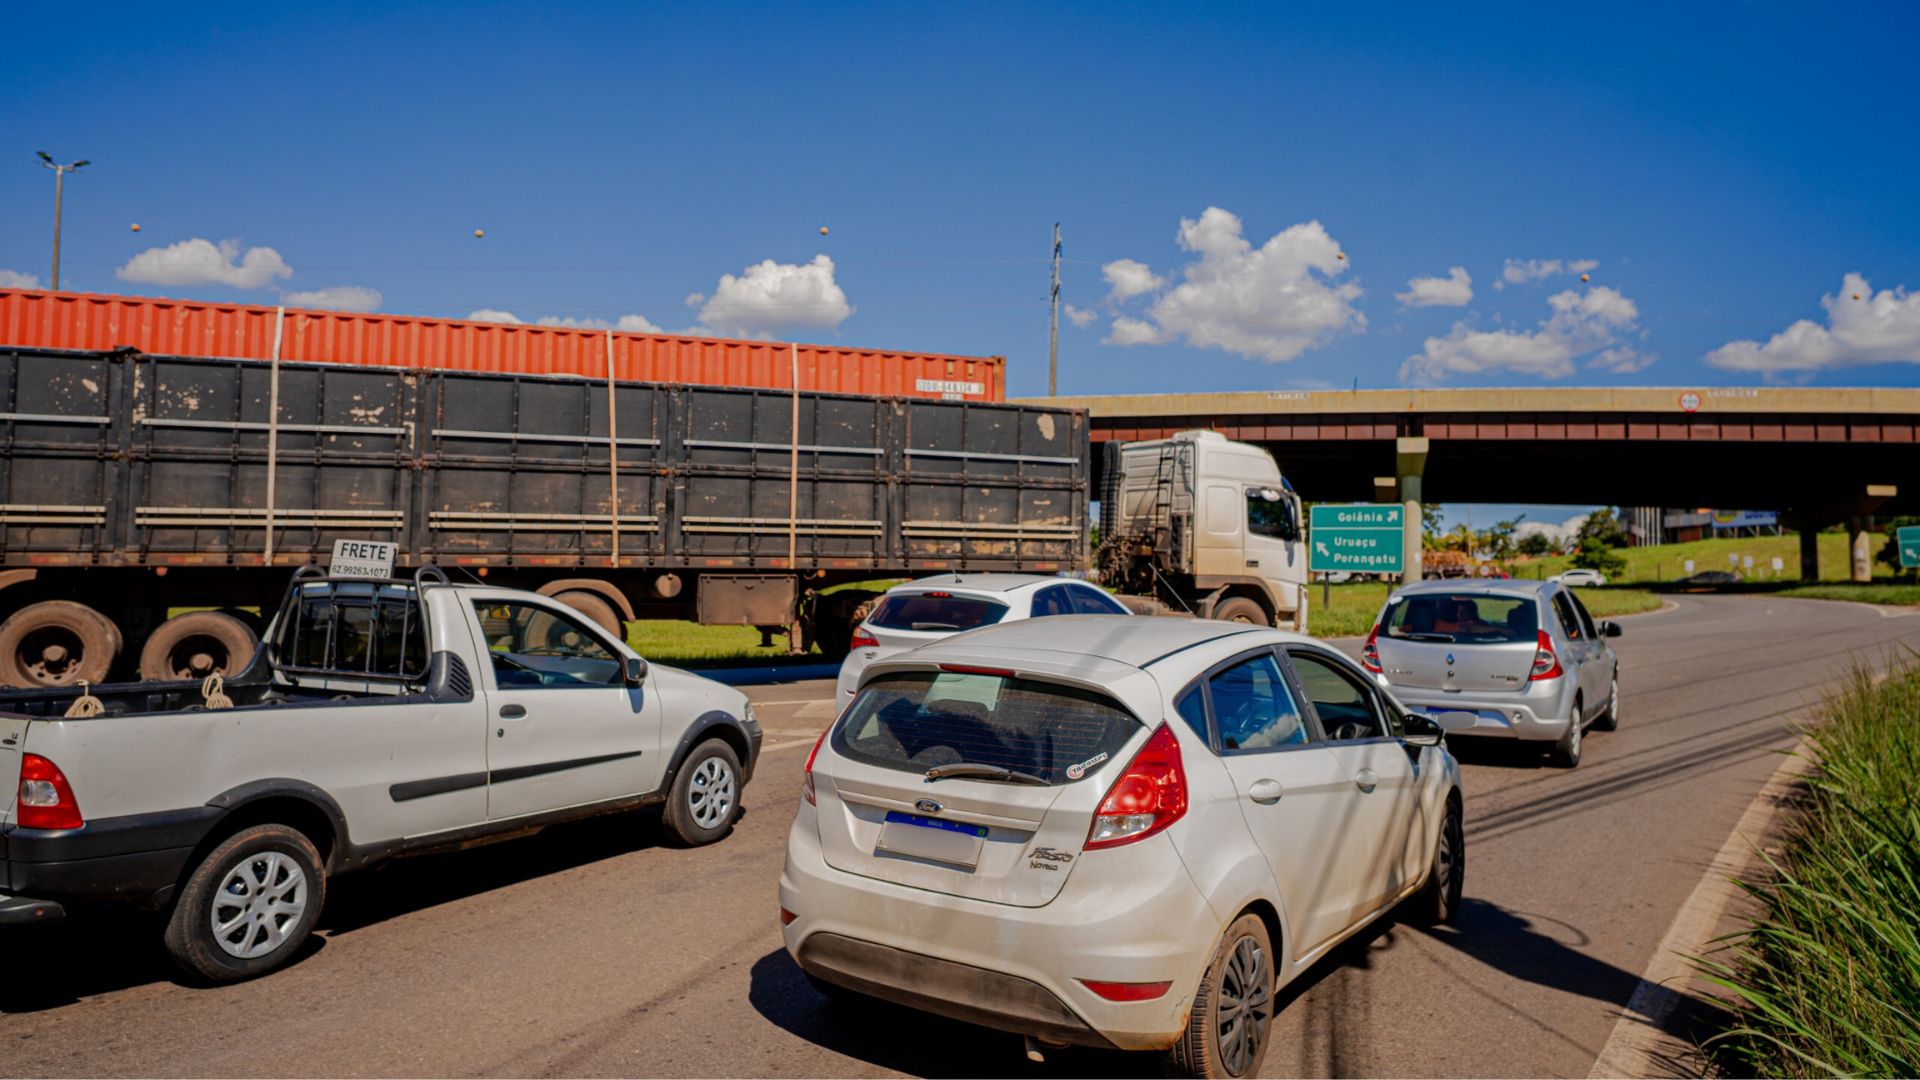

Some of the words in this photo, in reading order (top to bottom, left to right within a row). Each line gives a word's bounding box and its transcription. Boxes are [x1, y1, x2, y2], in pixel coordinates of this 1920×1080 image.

[1337, 510, 1383, 522] Goiânia
[1334, 537, 1377, 549] Uruaçu
[340, 542, 388, 560] FRETE
[1333, 553, 1396, 566] Porangatu
